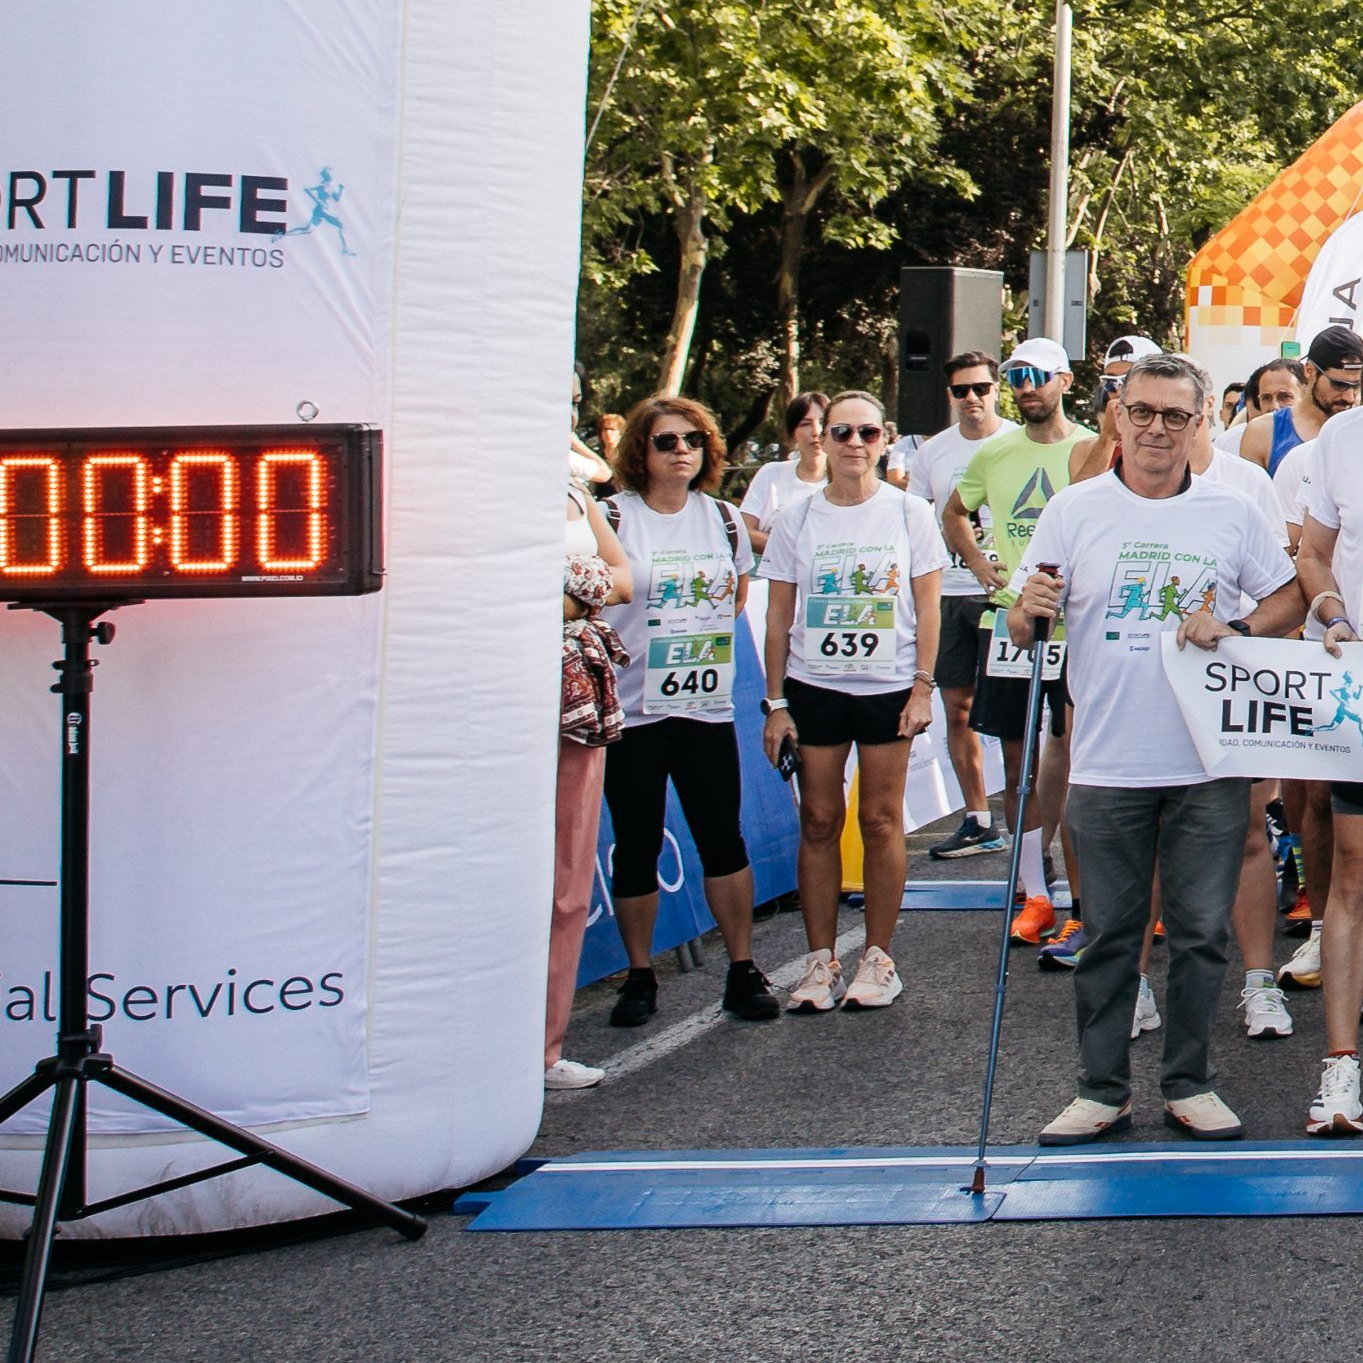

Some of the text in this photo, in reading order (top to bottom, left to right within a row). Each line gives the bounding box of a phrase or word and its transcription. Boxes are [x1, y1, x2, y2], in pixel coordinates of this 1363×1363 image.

[0, 170, 288, 235] RTLIFE
[0, 238, 285, 269] MUNICACIÓN Y EVENTOS
[1133, 542, 1169, 550] Carrera
[1119, 551, 1218, 568] MADRID CON LA
[824, 604, 876, 626] ELA
[666, 640, 716, 665] ELA
[821, 632, 880, 657] 639
[661, 668, 719, 696] 640
[1204, 661, 1332, 701] SPORT
[1221, 699, 1314, 738] LIFE
[1243, 739, 1306, 750] COMUNICACIÓN
[1307, 742, 1313, 750] Y
[1314, 743, 1351, 754] EVENTOS
[87, 971, 345, 1022] Services
